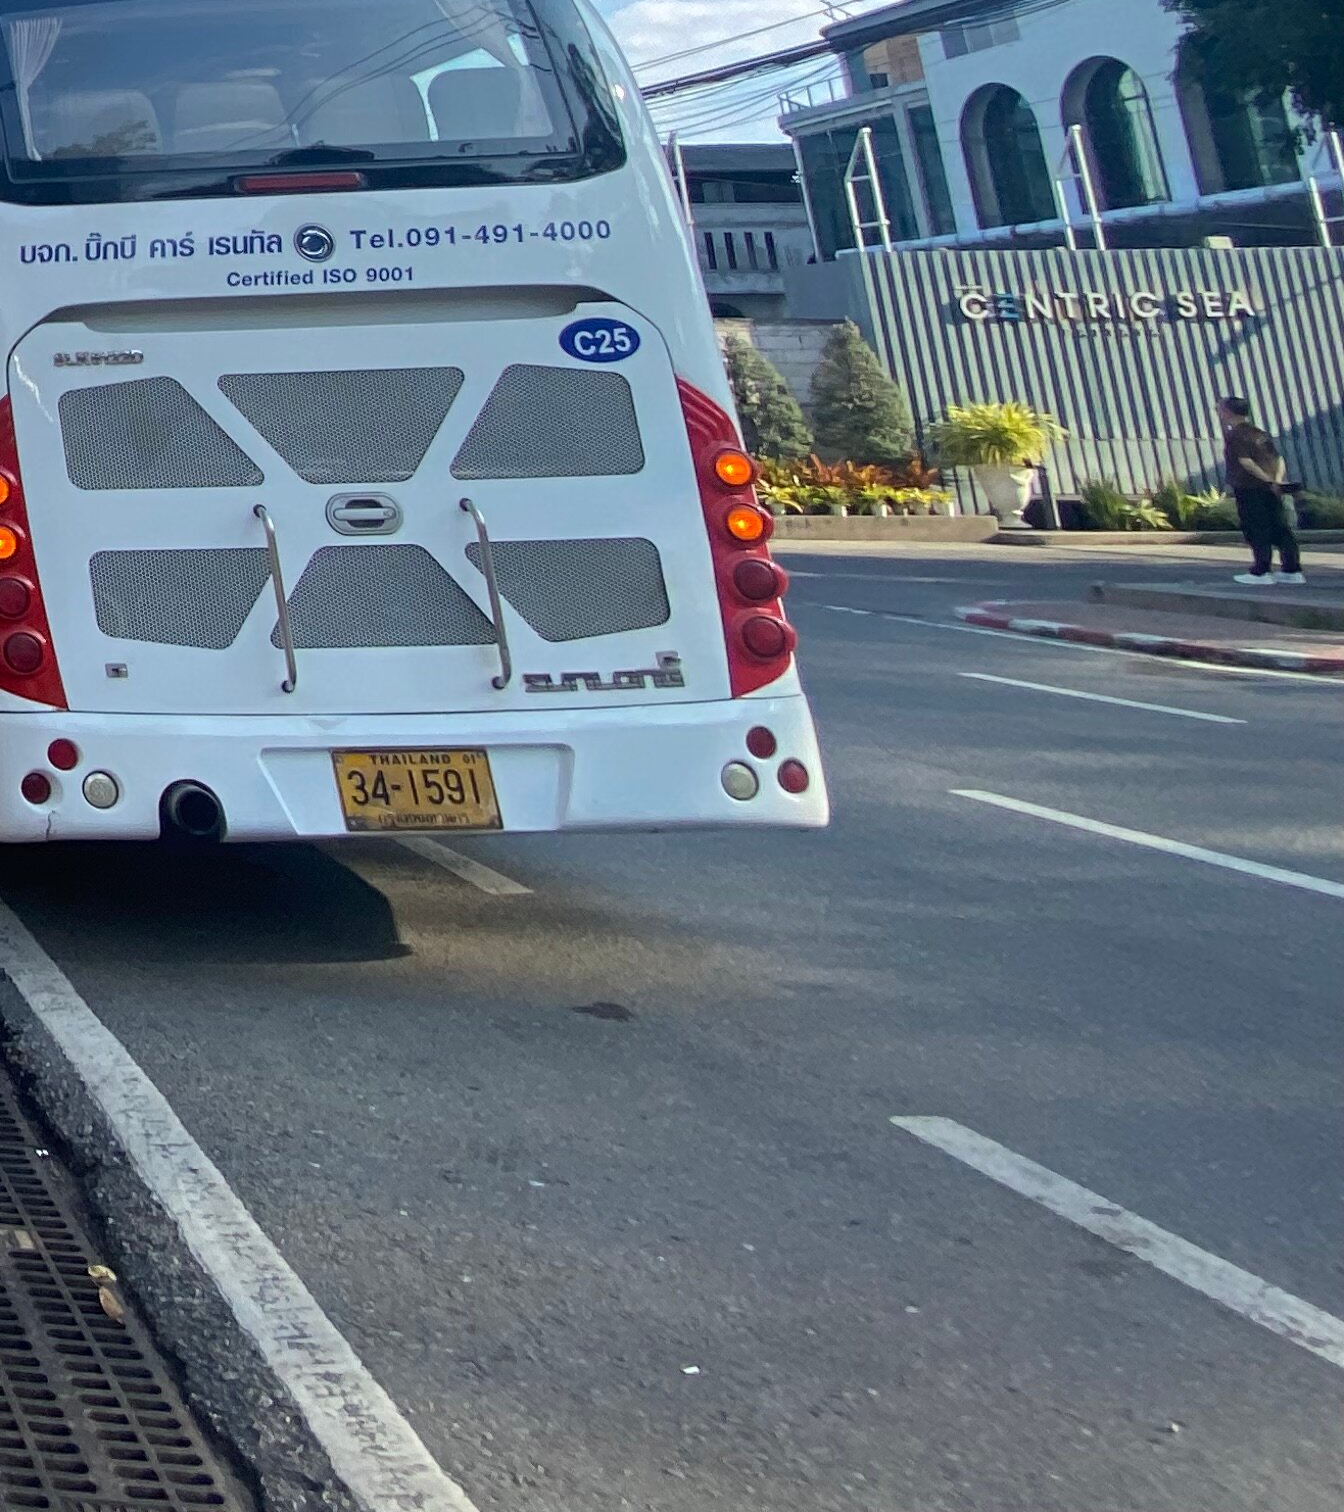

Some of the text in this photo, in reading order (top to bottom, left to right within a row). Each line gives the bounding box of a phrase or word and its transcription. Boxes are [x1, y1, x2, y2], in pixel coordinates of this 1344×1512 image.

[20, 229, 282, 264] บจก. บิ๊กบี คาร์ เรนทัล
[350, 220, 611, 250] Tel.091-491-4000
[227, 267, 414, 287] Certified ISO 9001
[960, 290, 1256, 321] CENTRIC SEA
[574, 328, 631, 356] C25
[368, 754, 451, 766] THAILAND
[347, 769, 481, 806] 34-1591
